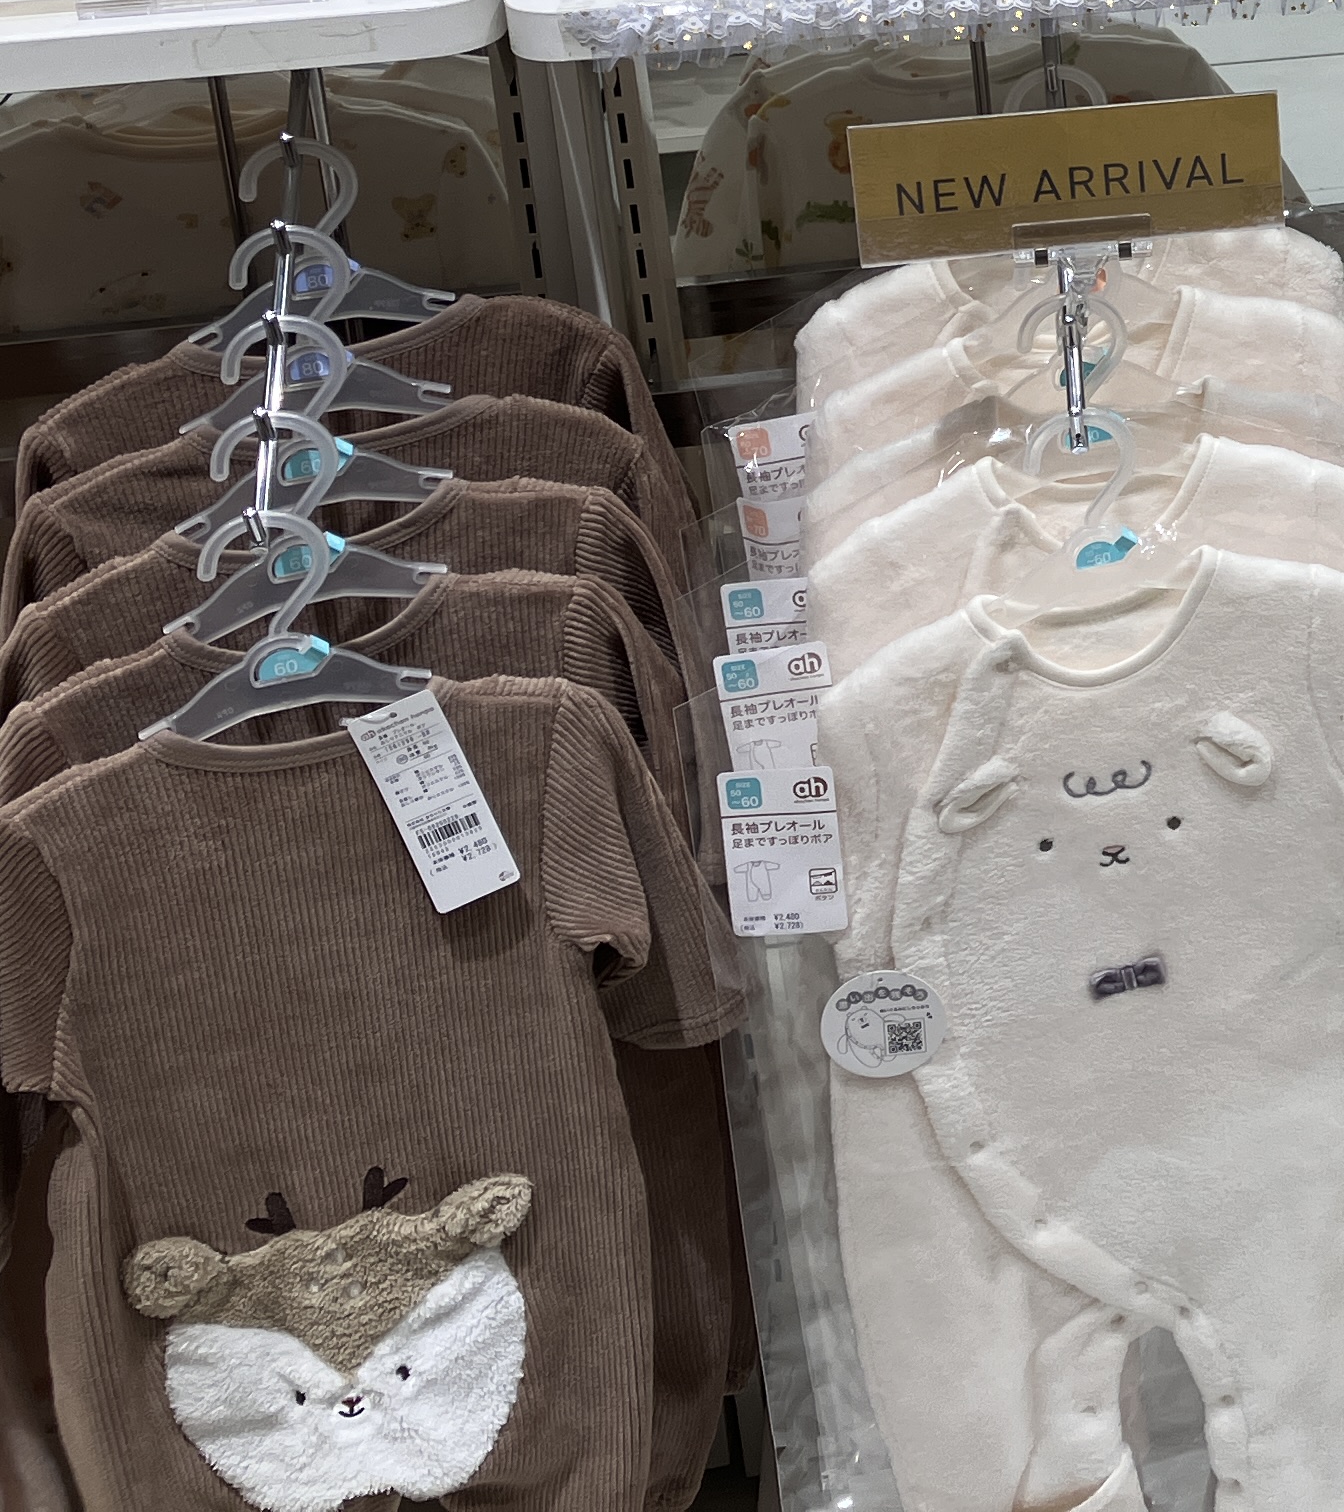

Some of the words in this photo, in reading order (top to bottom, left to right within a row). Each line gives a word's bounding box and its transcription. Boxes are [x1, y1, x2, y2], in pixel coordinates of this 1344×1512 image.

[897, 172, 1007, 216] NEW
[1033, 152, 1244, 204] ARRIVAL
[301, 361, 323, 376] 80
[273, 659, 298, 676] 60
[787, 652, 822, 676] ah
[793, 776, 828, 799] ah
[731, 819, 825, 835] 長袖プレオール
[732, 833, 833, 849] 足まですっぽりボア
